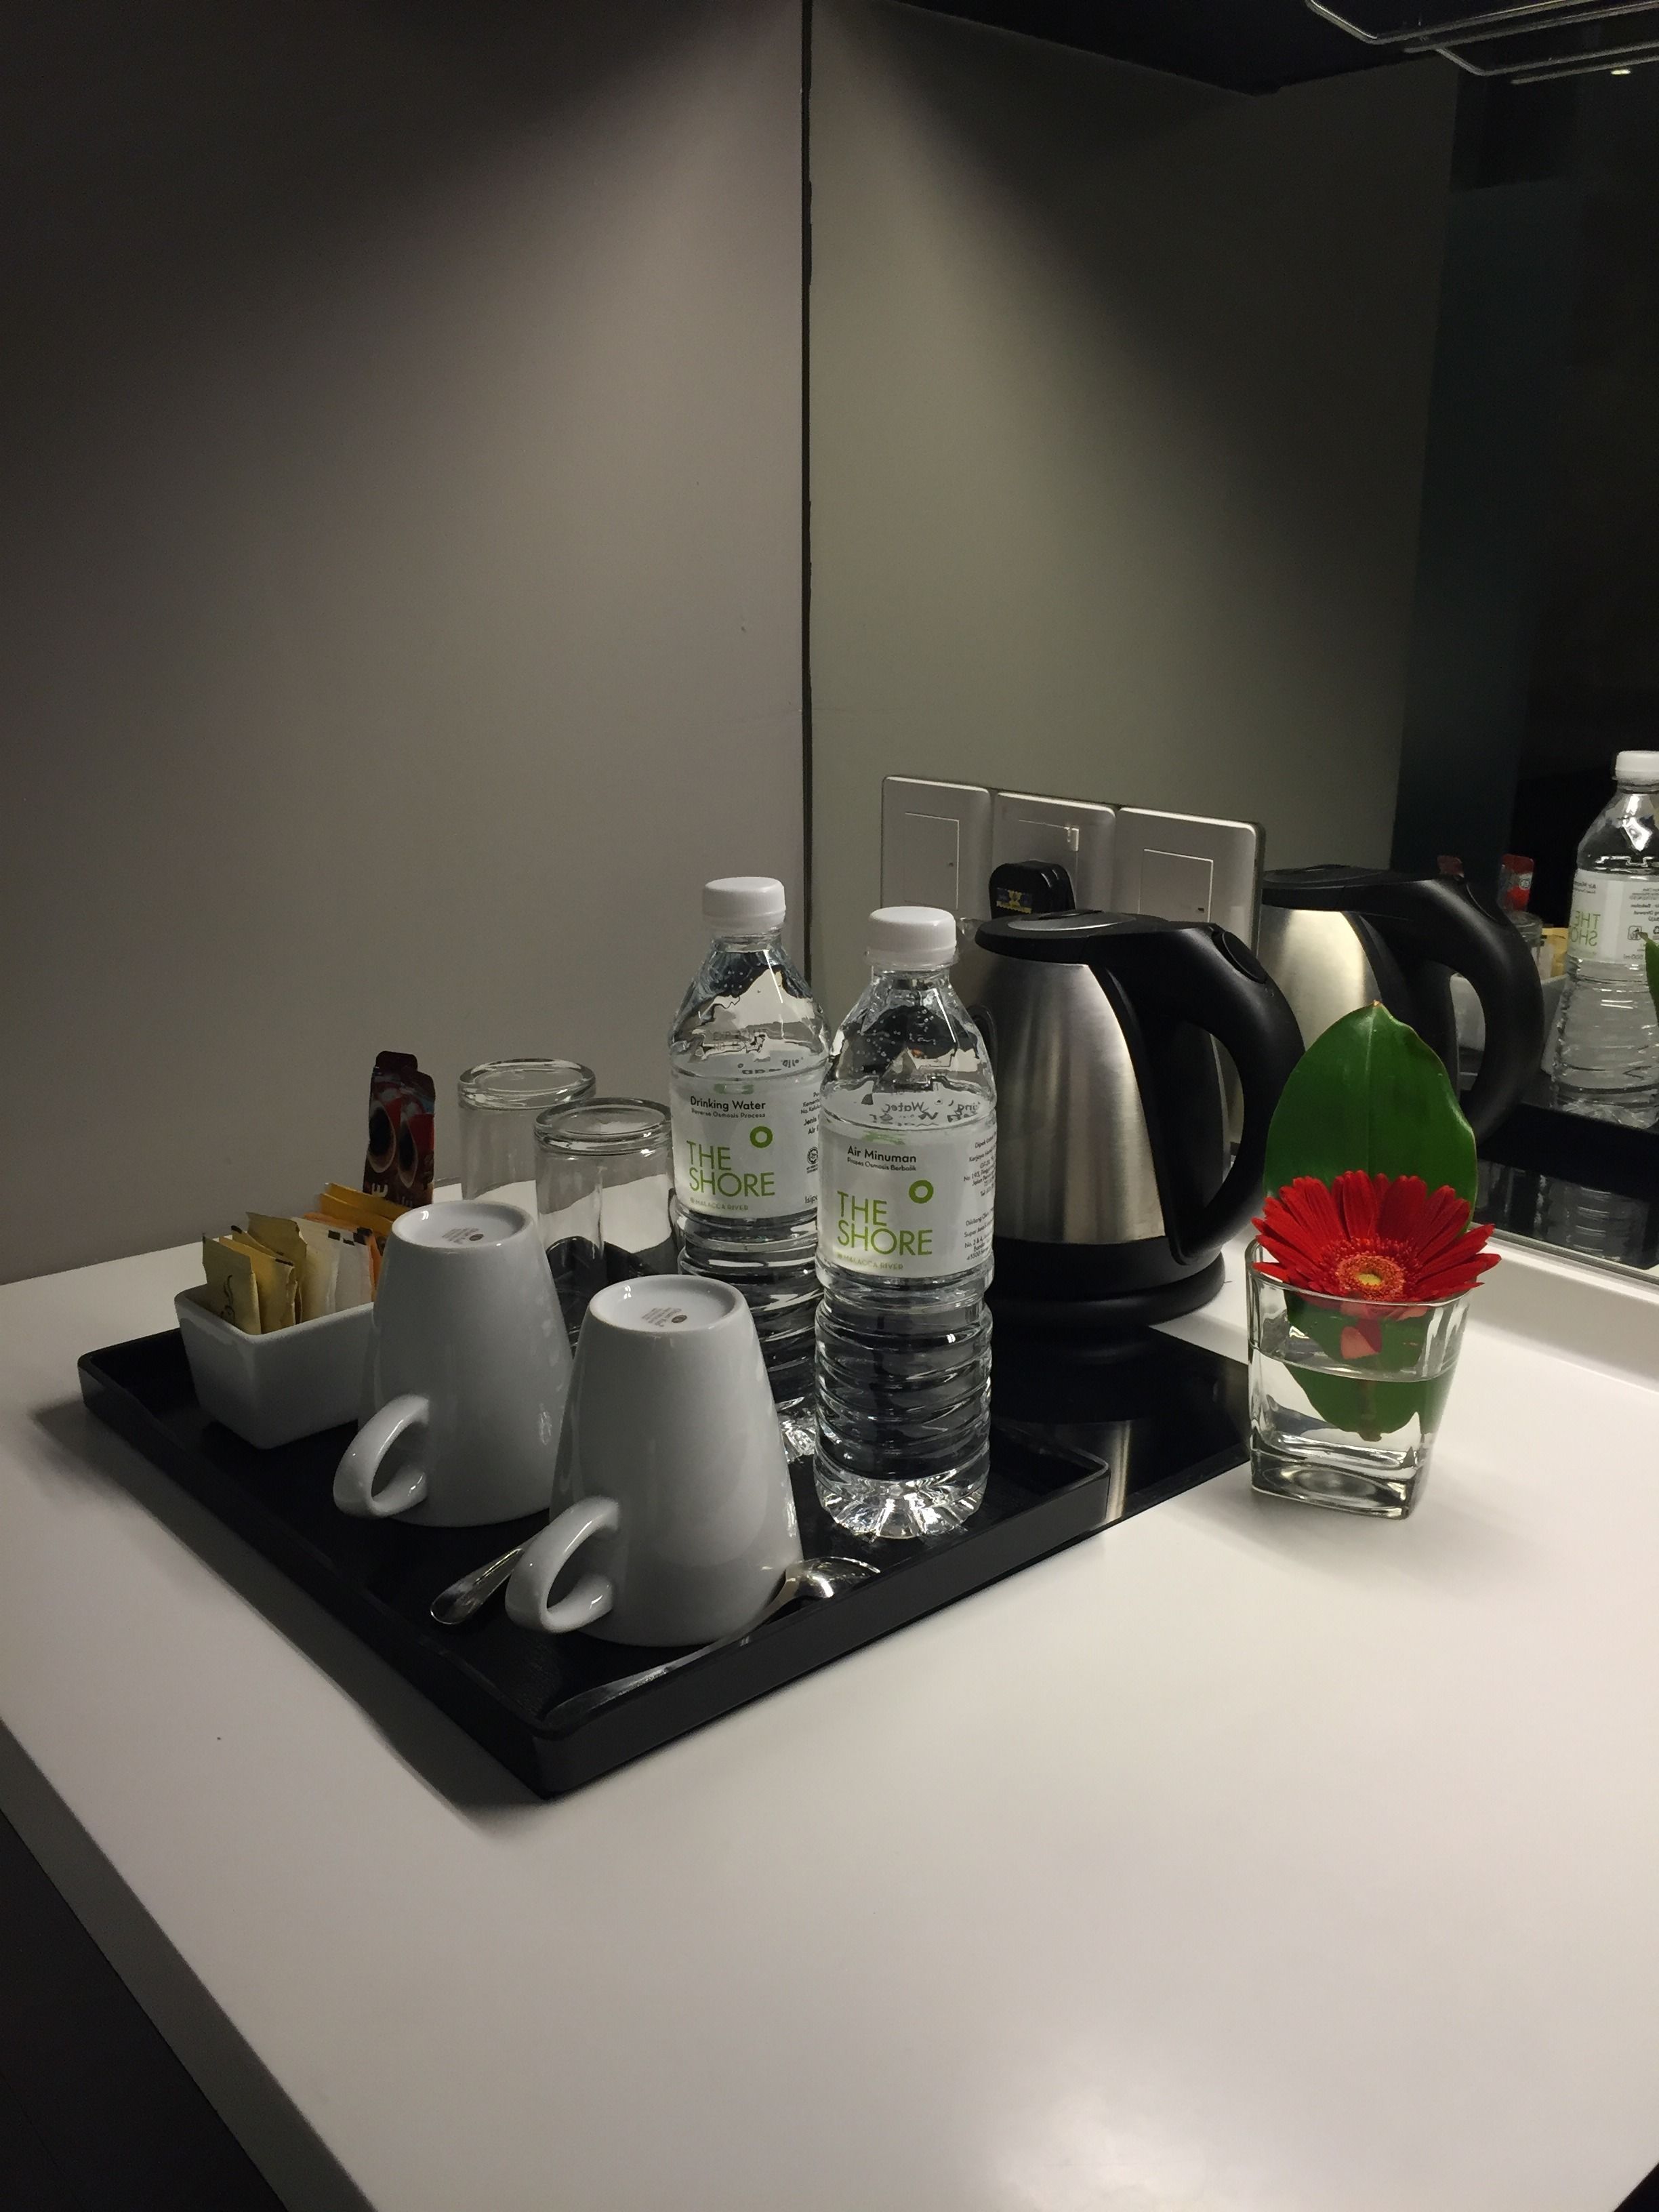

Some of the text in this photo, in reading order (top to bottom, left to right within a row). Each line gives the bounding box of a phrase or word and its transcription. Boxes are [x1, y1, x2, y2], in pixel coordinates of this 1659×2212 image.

[691, 1096, 766, 1112] Drinking Water
[804, 1117, 817, 1126] Jenis
[687, 1141, 731, 1170] THE
[847, 1146, 916, 1163] Air Minuman
[865, 1161, 890, 1170] Osmosis
[689, 1167, 775, 1197] SHORE
[837, 1191, 887, 1226] THE
[838, 1220, 933, 1256] SHORE
